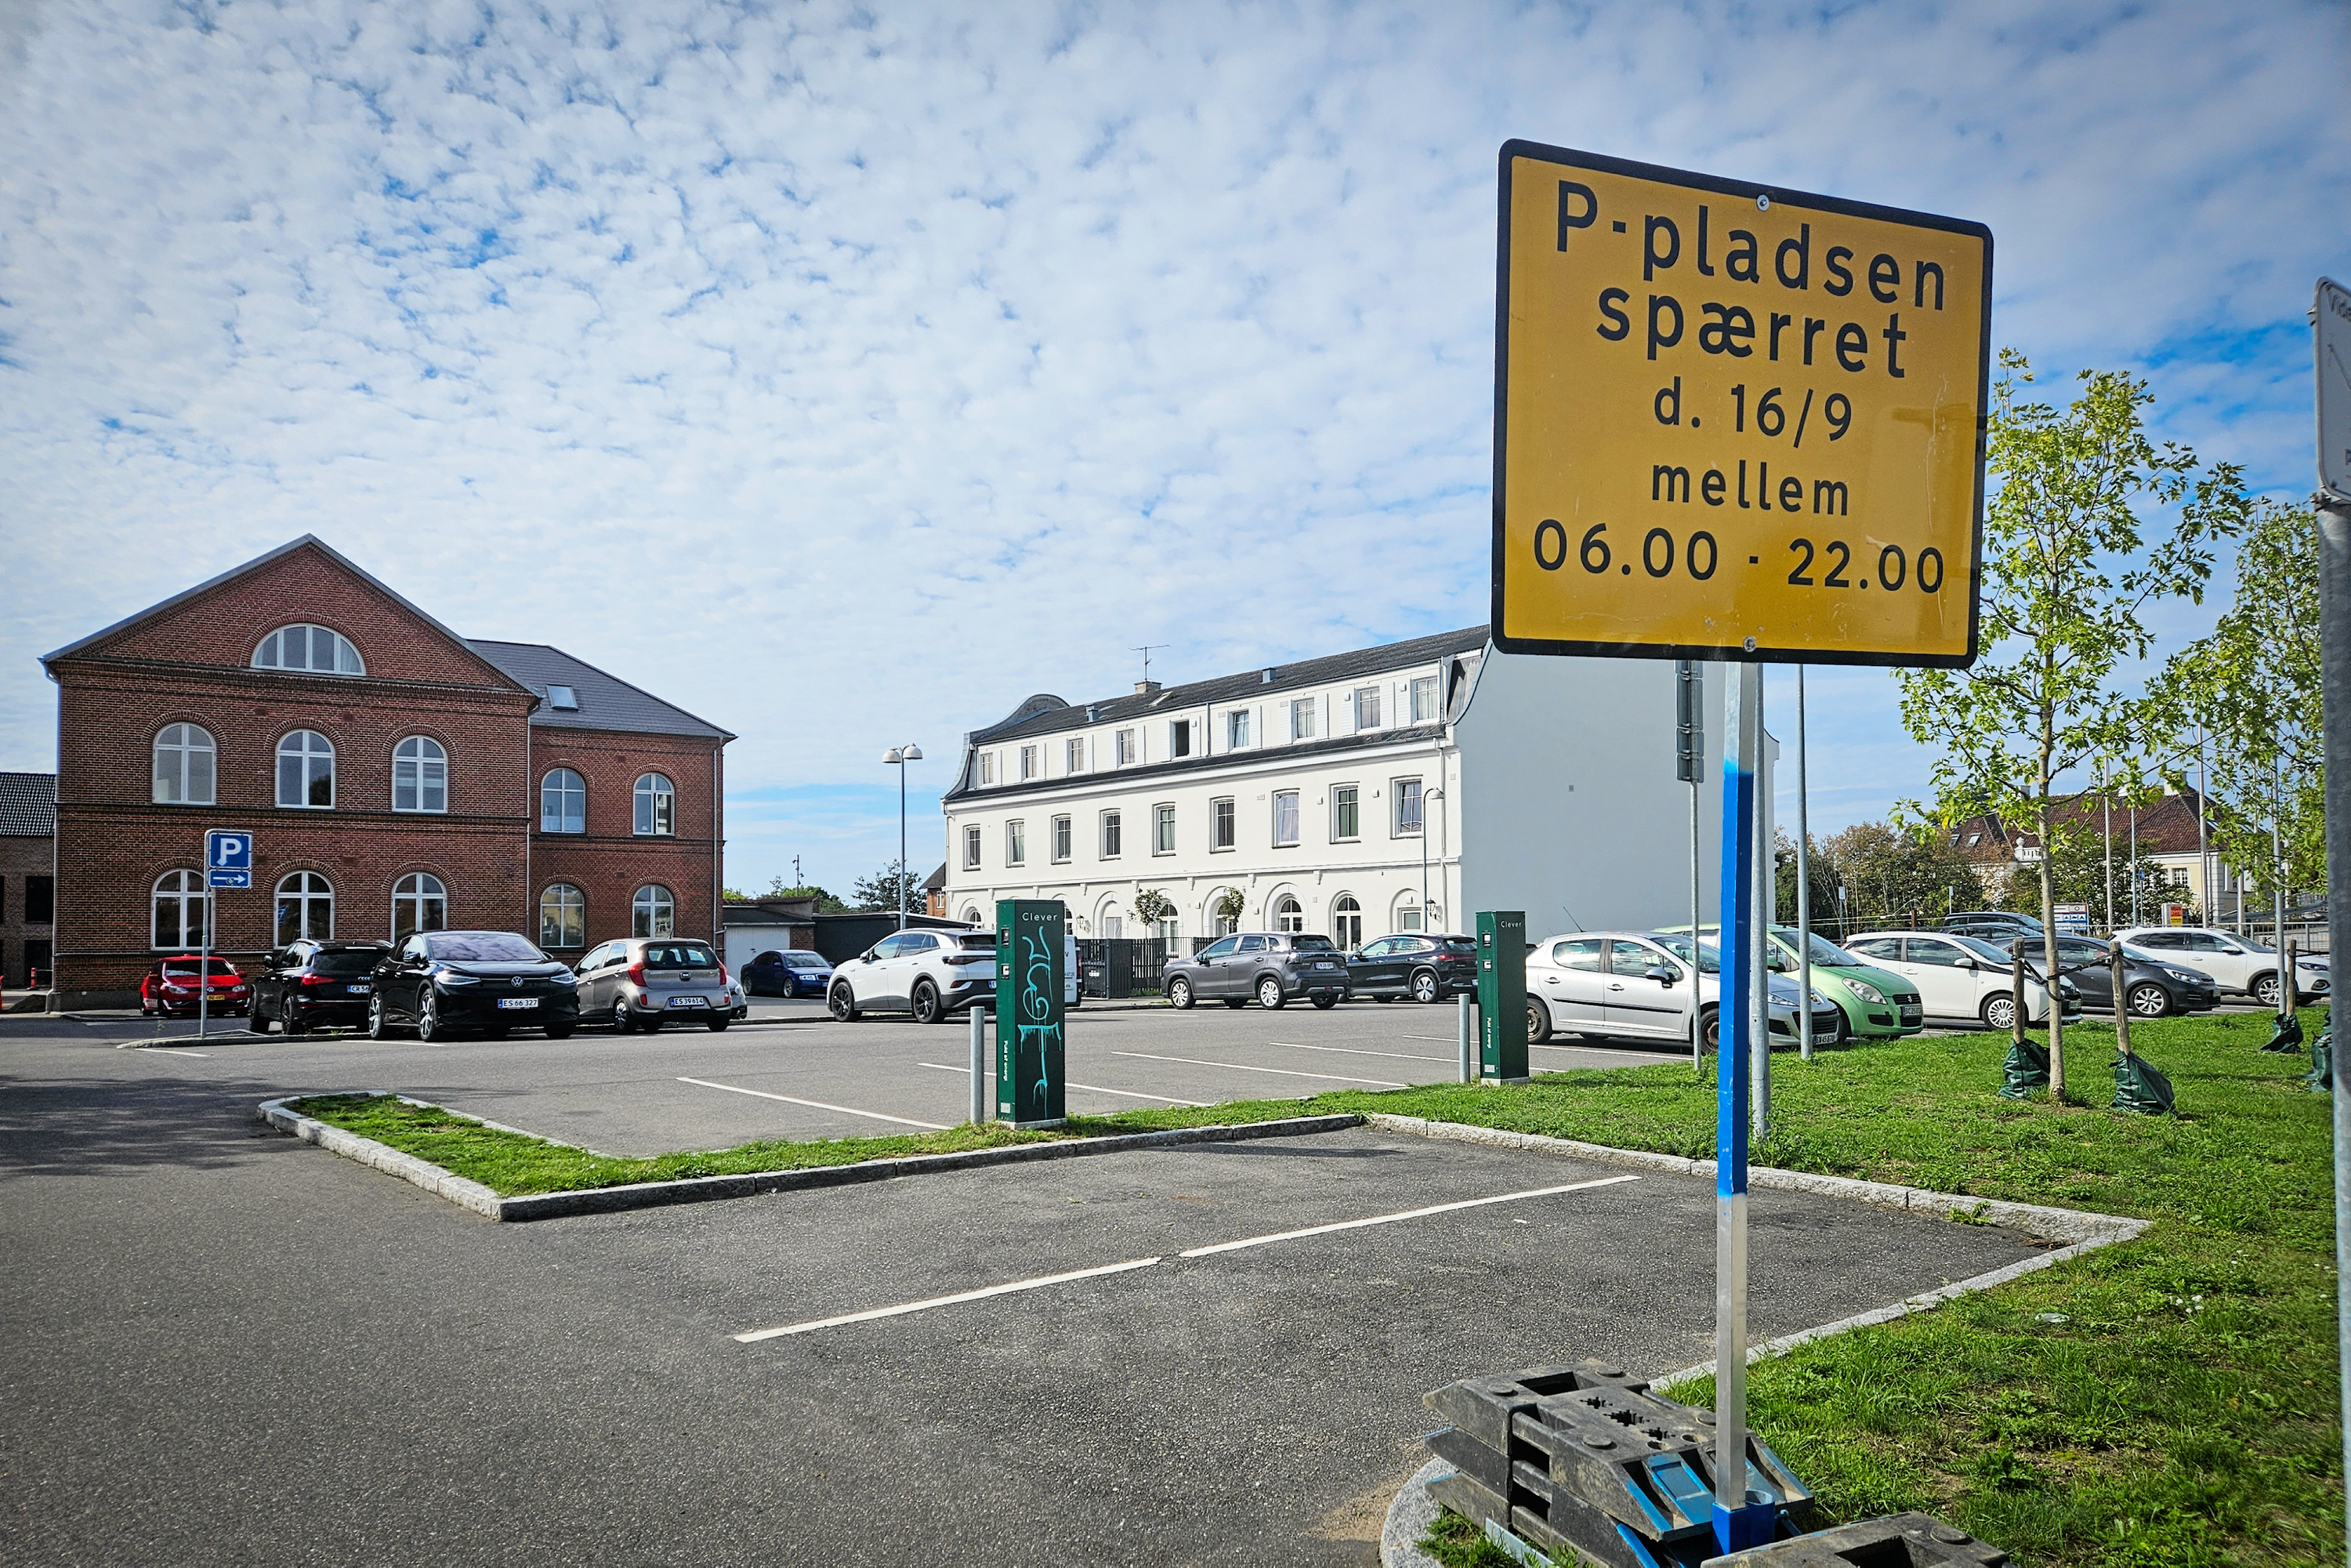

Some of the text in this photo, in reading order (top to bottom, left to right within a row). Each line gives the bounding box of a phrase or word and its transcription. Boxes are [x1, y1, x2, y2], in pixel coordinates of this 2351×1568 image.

[1556, 179, 1944, 311] P-pladsen
[1596, 287, 1907, 378] spærret
[1654, 376, 1852, 448] d. 16/9
[1652, 459, 1848, 516] mellem
[1534, 519, 1944, 593] 06.00 - 22.00
[216, 838, 242, 867] P
[1022, 912, 1058, 922] Clever
